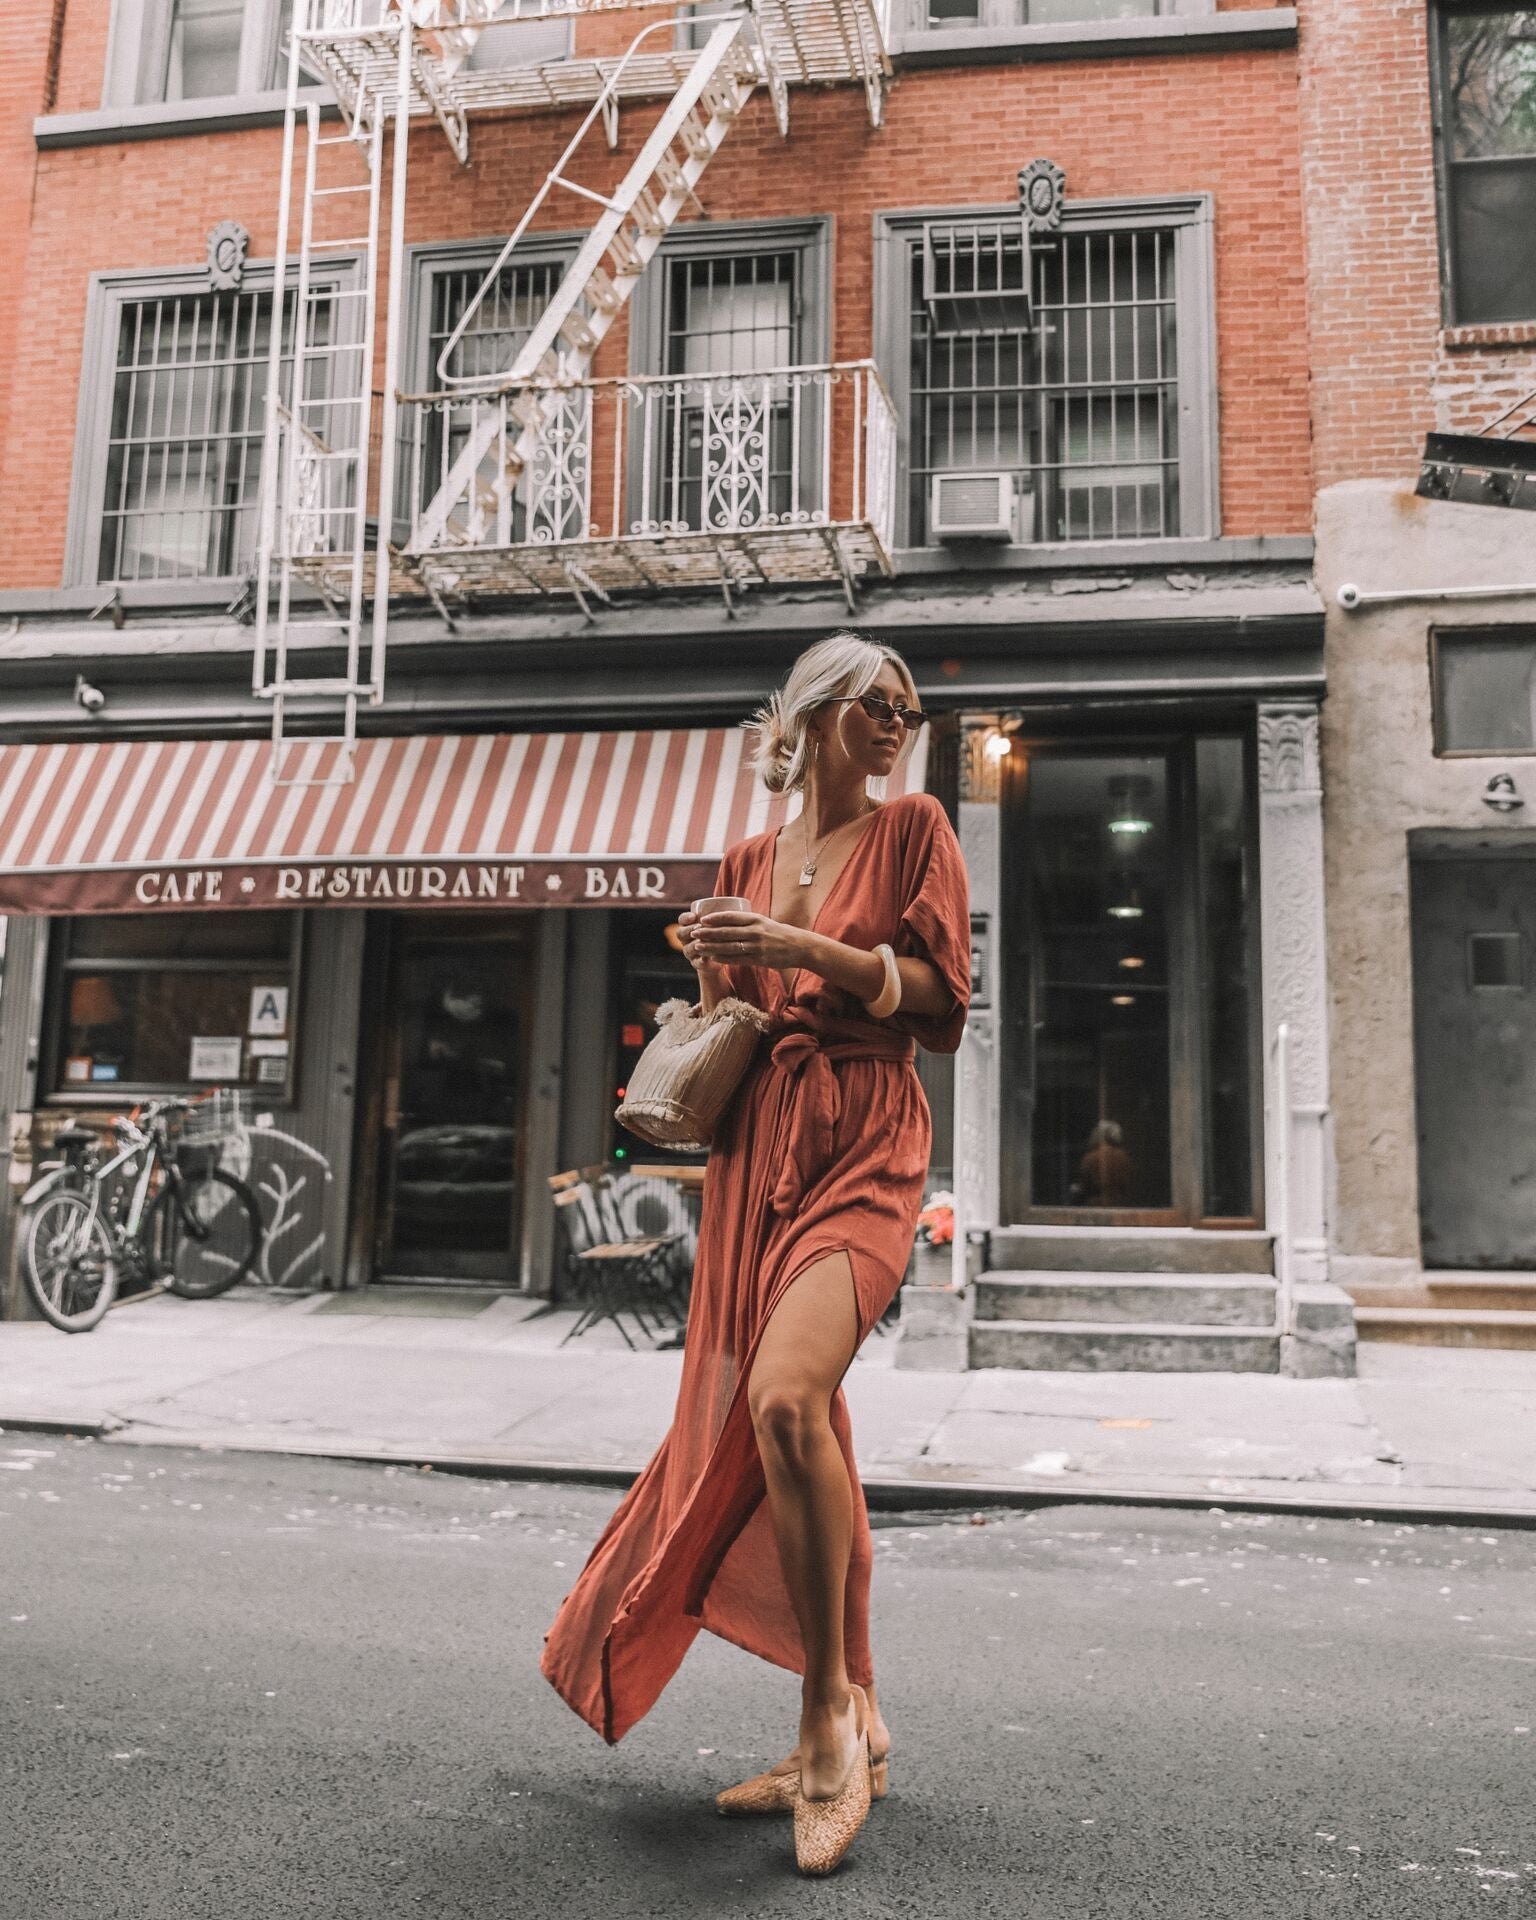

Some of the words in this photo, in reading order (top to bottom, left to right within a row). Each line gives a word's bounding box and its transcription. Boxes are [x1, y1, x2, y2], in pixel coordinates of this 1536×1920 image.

[135, 872, 222, 903] CAFE
[276, 867, 524, 899] RESTAURANT
[585, 868, 666, 898] BAR
[257, 993, 279, 1020] A
